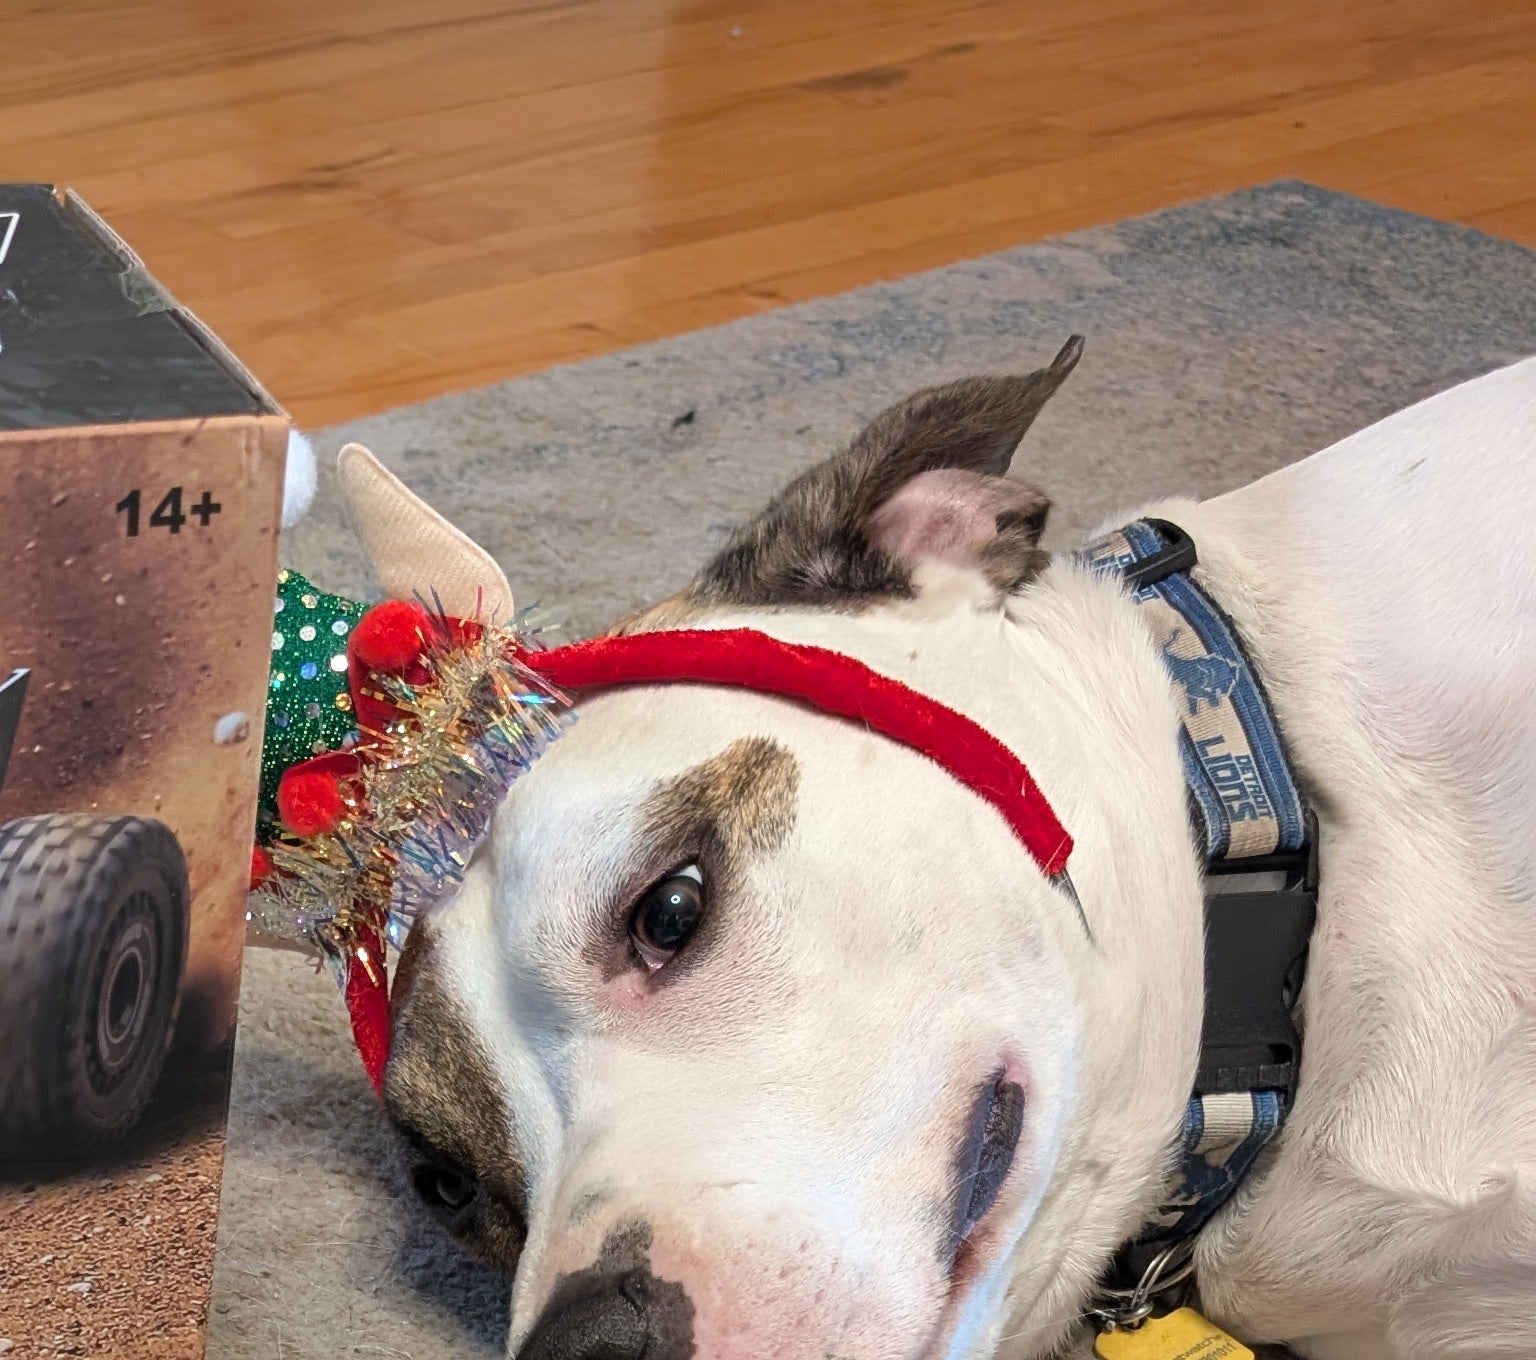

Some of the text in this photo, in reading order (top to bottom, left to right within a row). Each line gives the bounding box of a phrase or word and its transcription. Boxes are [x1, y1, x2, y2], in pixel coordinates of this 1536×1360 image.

[115, 487, 221, 537] 14+
[1195, 734, 1259, 823] LIONS
[1234, 754, 1271, 820] DETROIT
